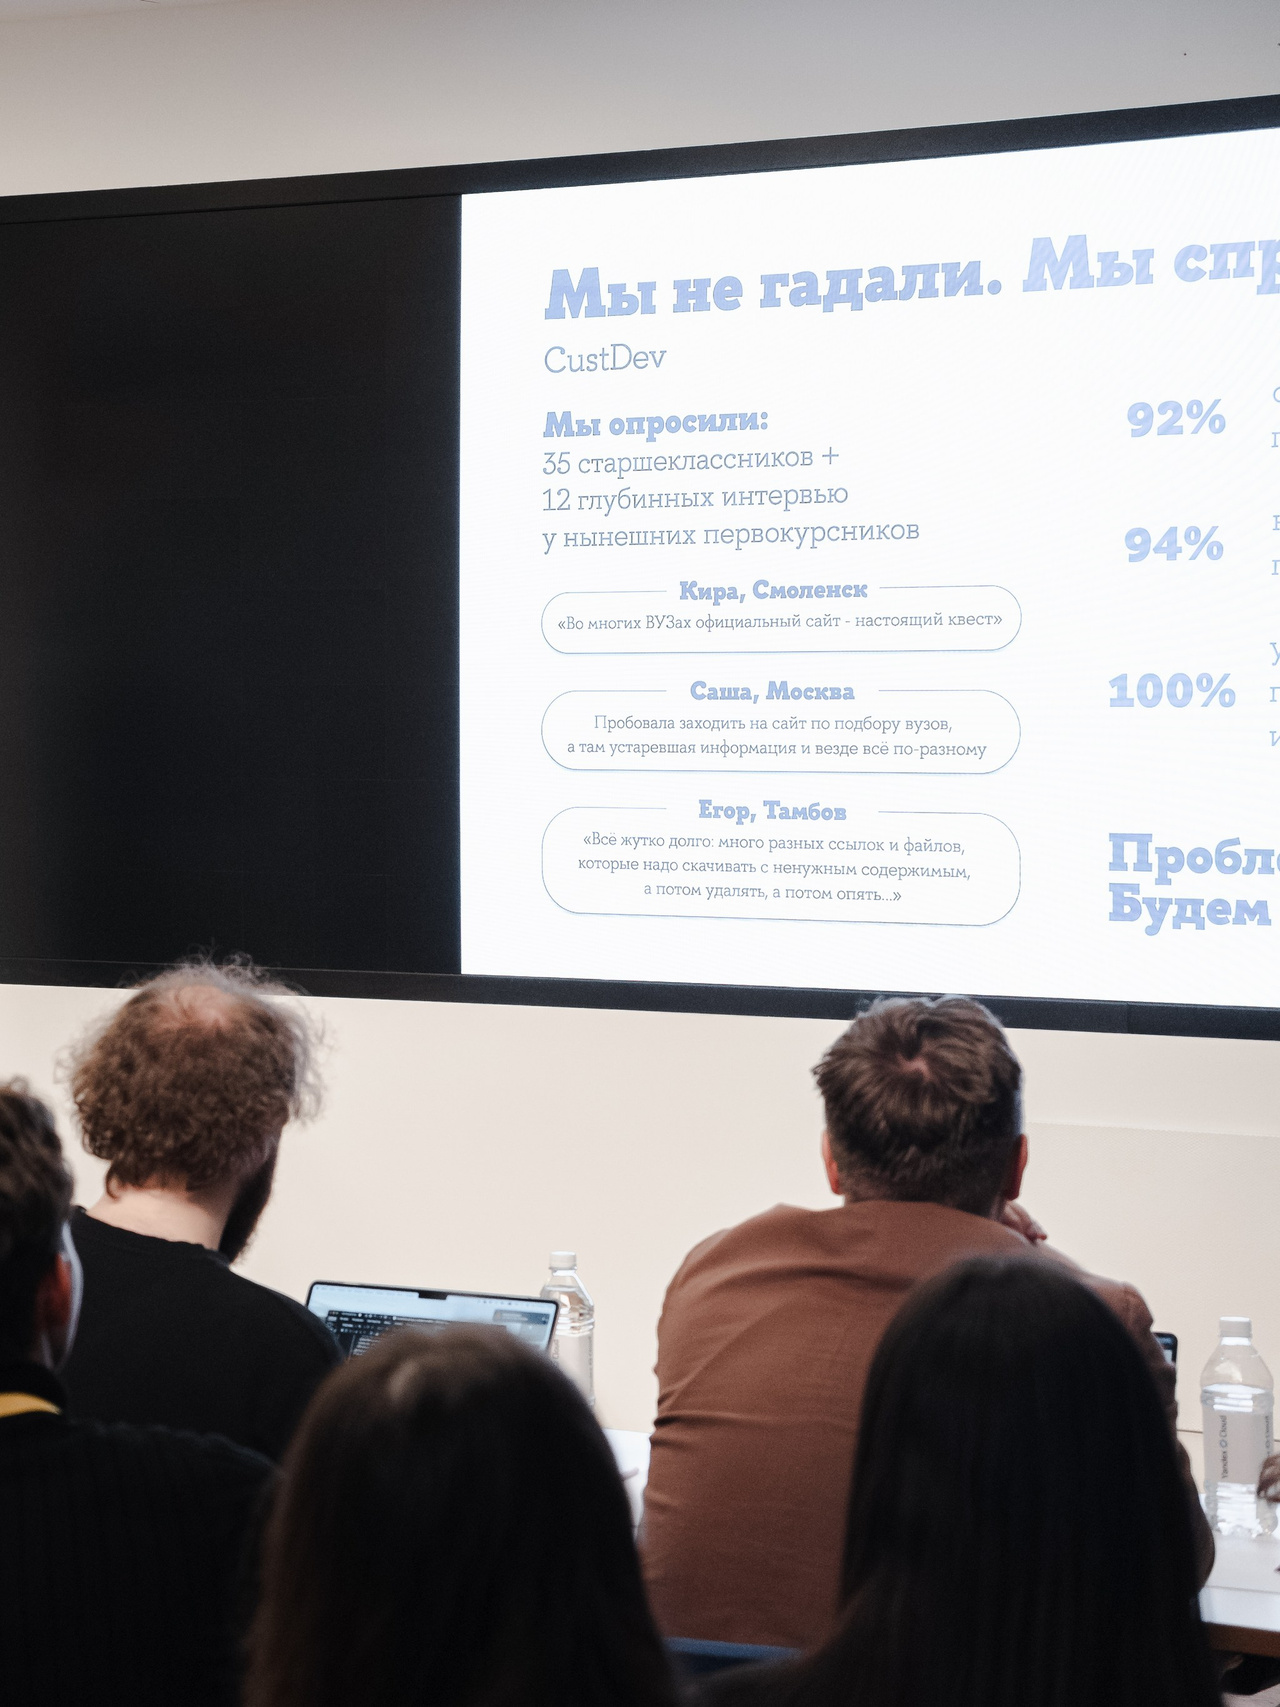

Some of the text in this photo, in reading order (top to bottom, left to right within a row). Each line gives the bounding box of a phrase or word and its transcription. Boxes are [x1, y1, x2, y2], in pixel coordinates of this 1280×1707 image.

[544, 266, 657, 321] Мы
[672, 275, 744, 314] не
[759, 259, 1003, 314] гадали.
[1022, 233, 1155, 293] Мы
[543, 342, 668, 374] CustDev
[542, 410, 769, 444] Мы опросили:
[1126, 398, 1227, 438] 92%
[542, 451, 571, 476] 35
[577, 450, 814, 480] старшеклассников
[542, 485, 849, 518] 12 глубинных интервью
[541, 523, 920, 556] у нынешних первокурсников
[1124, 525, 1225, 563] 94%
[679, 578, 869, 607] Кира, Смоленск
[557, 615, 584, 631] «Во
[587, 619, 642, 630] многих
[645, 614, 692, 630] ВУЗах
[695, 613, 802, 633] официальный
[805, 613, 842, 628] сайт
[854, 611, 944, 629] настоящий
[947, 614, 1003, 626] квест»
[689, 680, 856, 705] Саша, Москва
[1108, 672, 1237, 709] 100%
[594, 714, 953, 735] Пробовала заходить на сайт по подбору вузов,
[567, 738, 988, 761] а там устаревшая информация и везде всё по-разному
[698, 798, 848, 826] Егор, Тамбов
[583, 831, 965, 857] «Всё жутко долго: много разных ссылок и файлов,
[1108, 832, 1280, 887] Пробл
[578, 859, 971, 881] которые надо скачивать с ненужным содержимым,
[643, 884, 902, 902] а потом удалять, а потом опять...»
[1108, 882, 1273, 937] Будем
